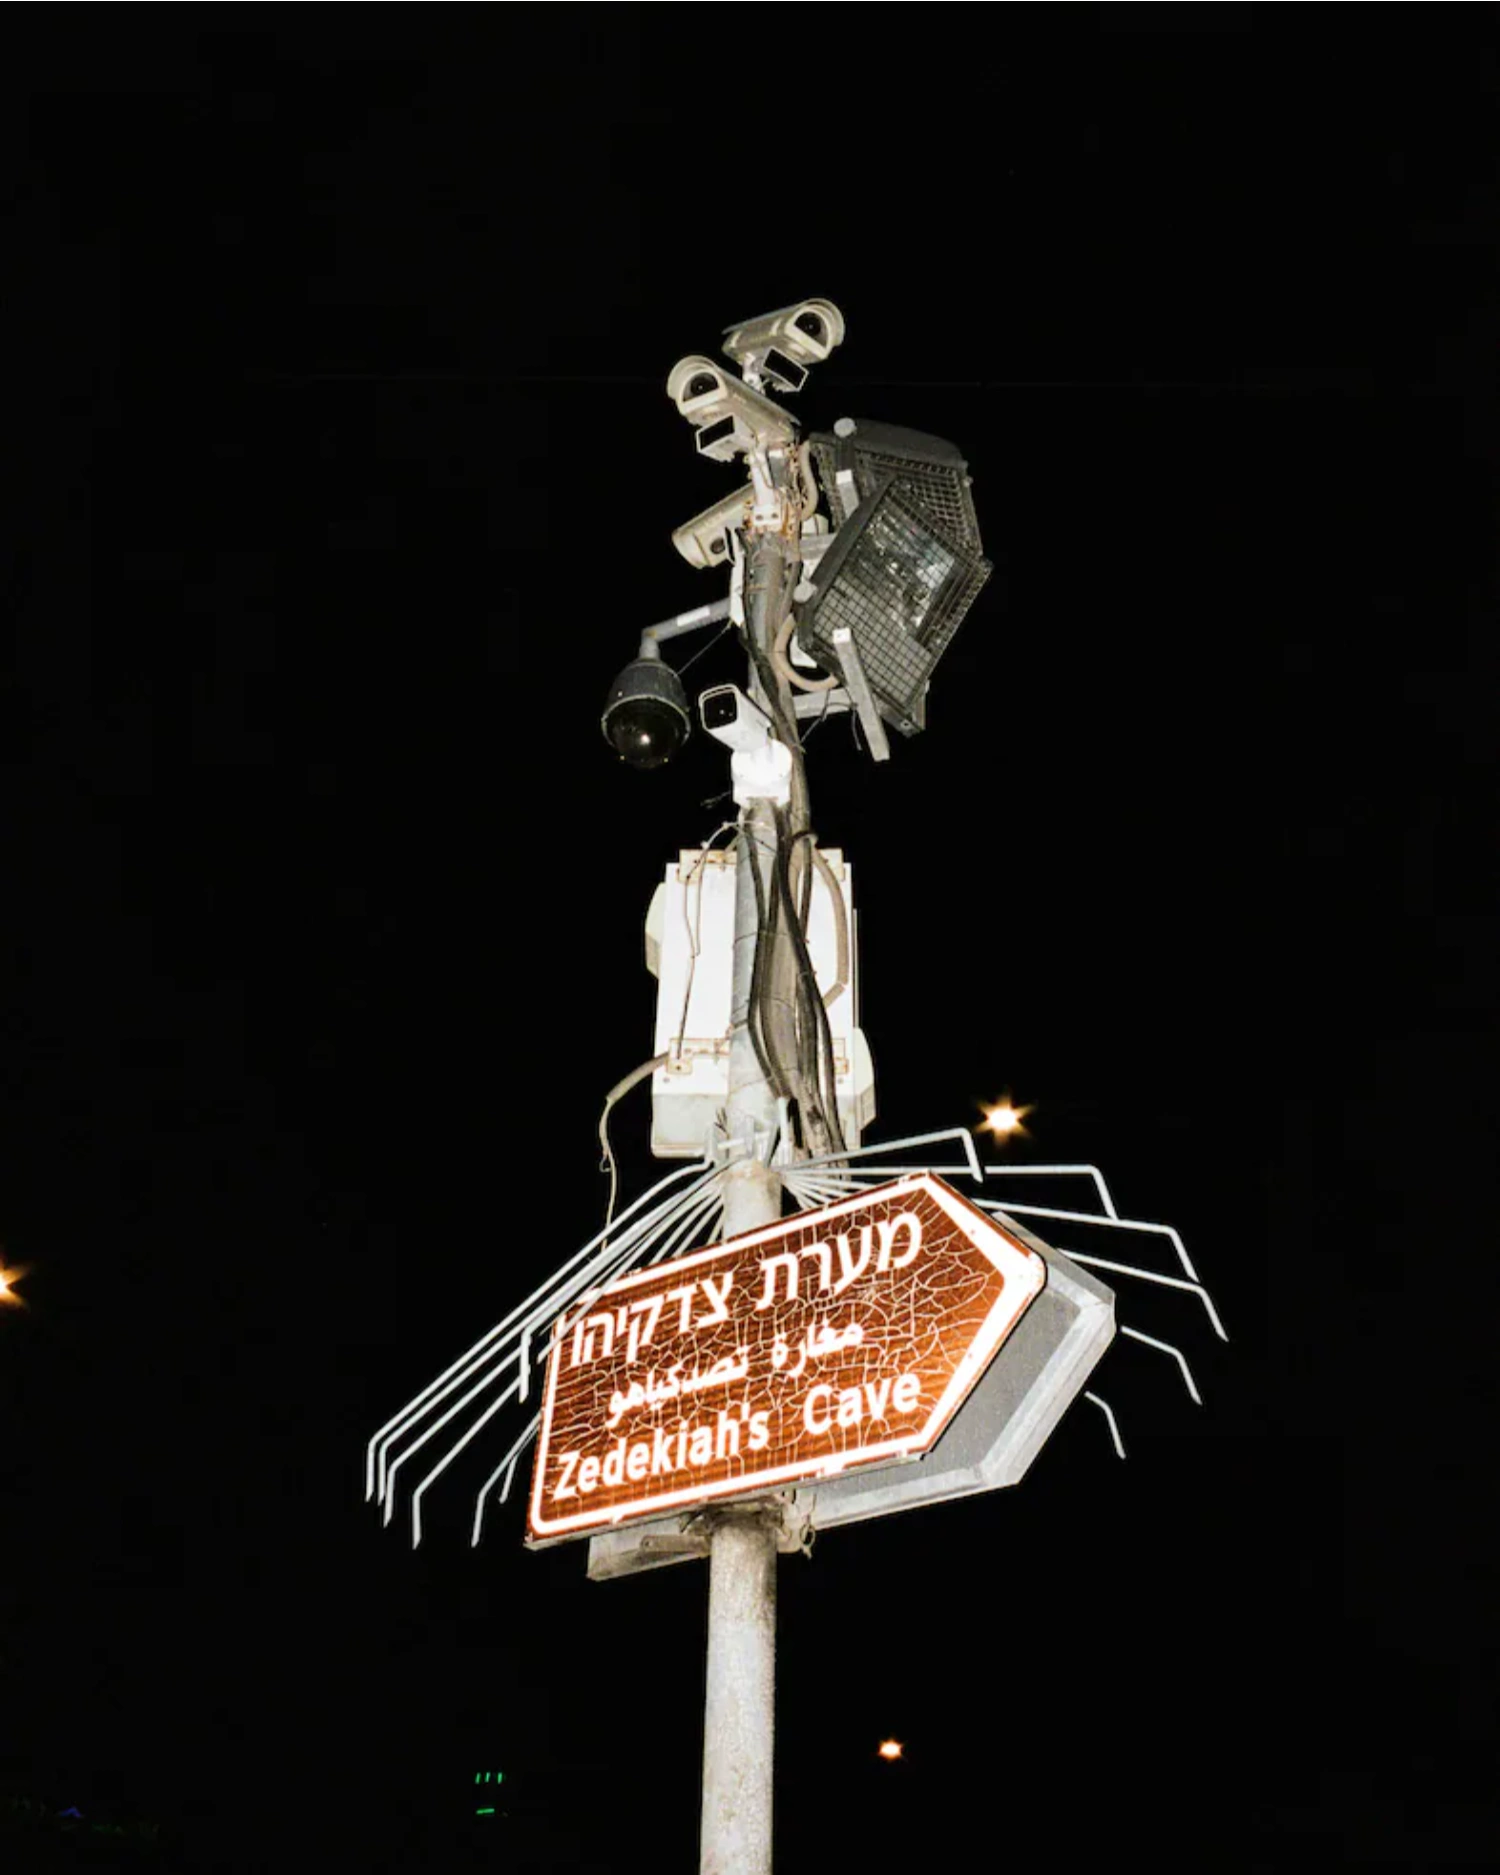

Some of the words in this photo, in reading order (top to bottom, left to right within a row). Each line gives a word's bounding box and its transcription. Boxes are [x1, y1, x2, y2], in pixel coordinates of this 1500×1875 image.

[756, 1212, 923, 1311] מערת
[569, 1271, 734, 1368] צדקיהו
[771, 1319, 864, 1379] مغارة
[554, 1403, 770, 1500] Zedekiah's
[803, 1372, 921, 1435] Cave
